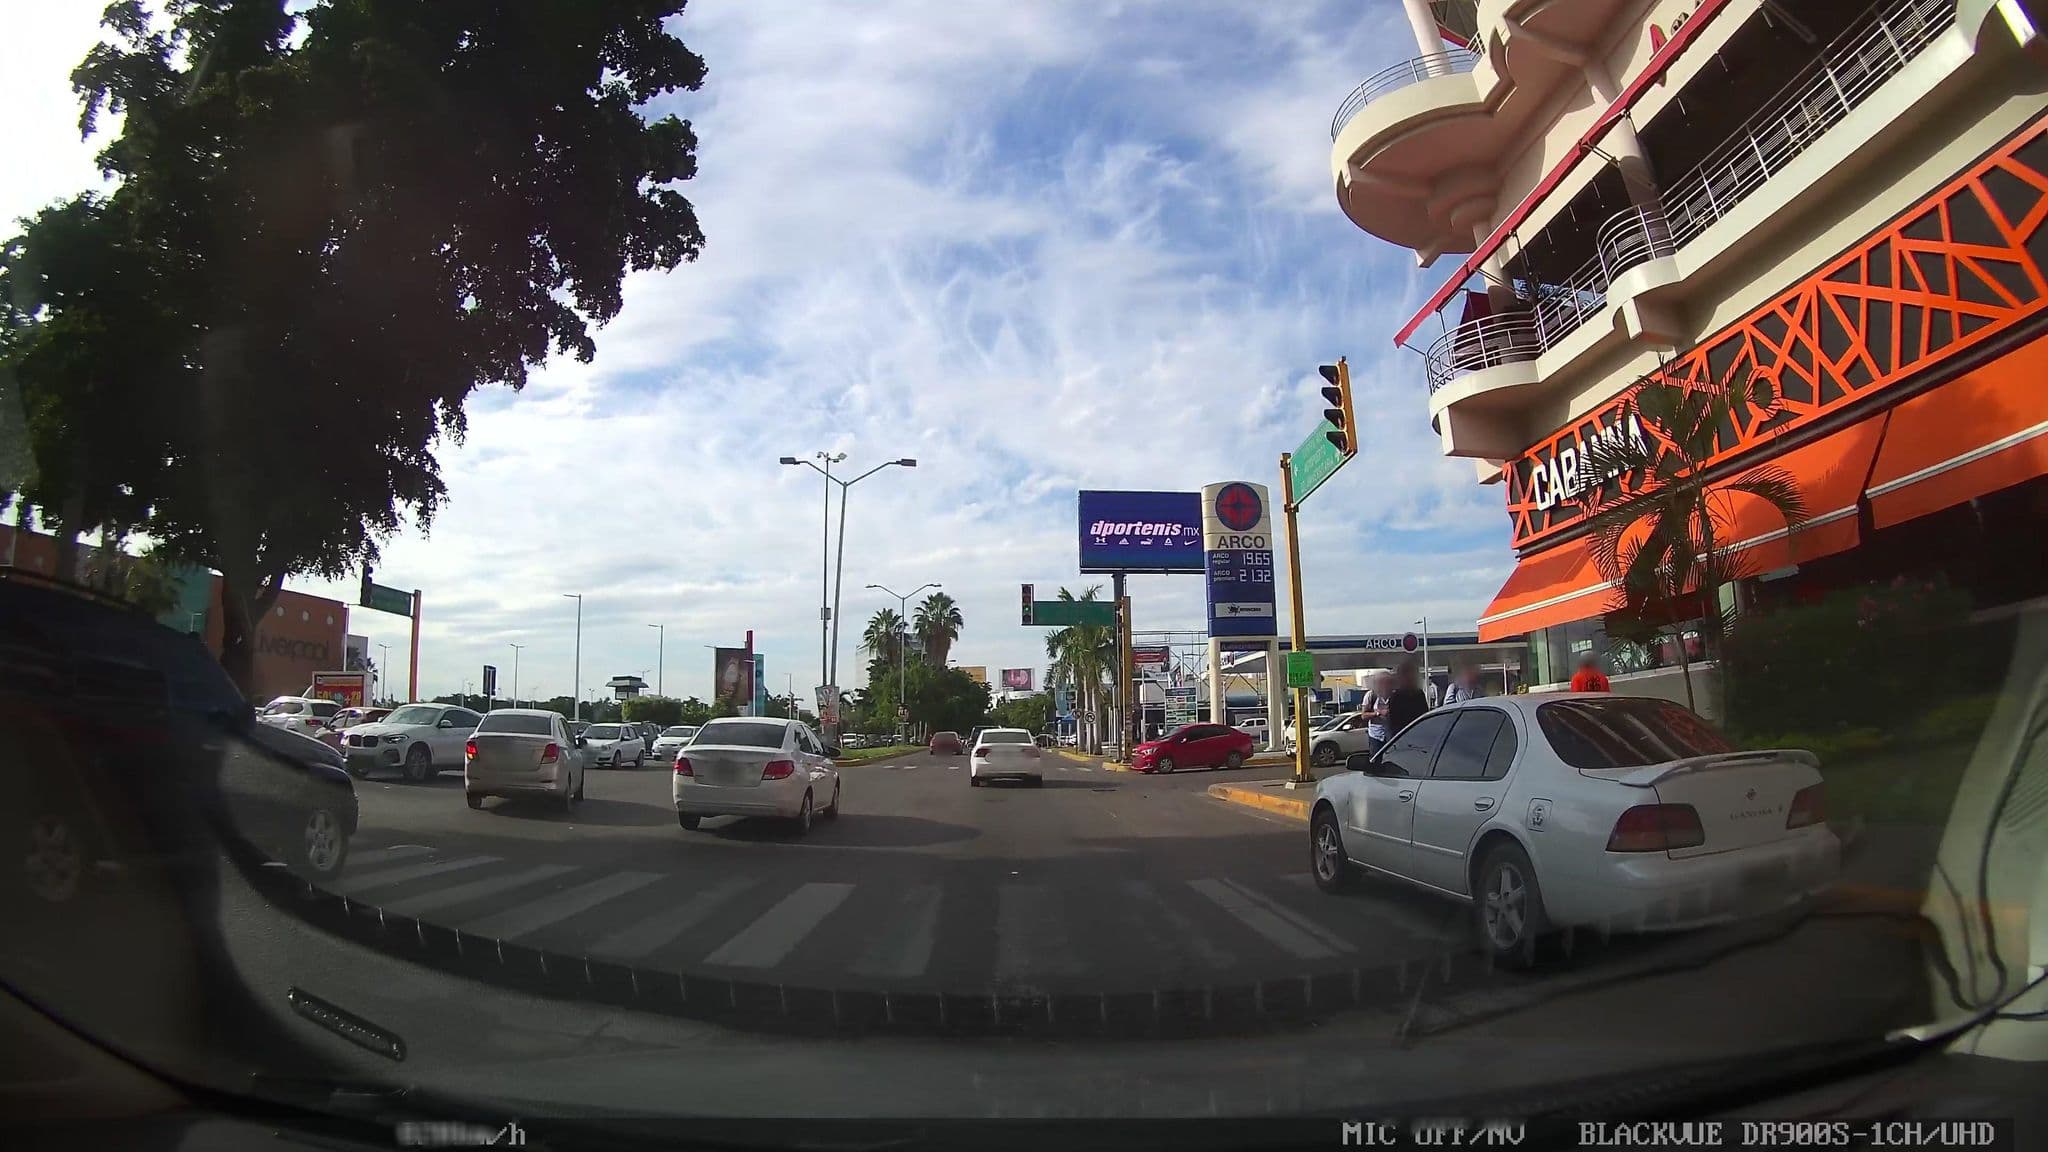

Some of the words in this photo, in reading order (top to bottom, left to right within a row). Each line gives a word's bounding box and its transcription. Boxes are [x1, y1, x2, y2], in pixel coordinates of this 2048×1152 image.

[1090, 520, 1199, 537] dportenis.mx
[1217, 535, 1265, 549] ARCO
[1243, 552, 1270, 565] 19.65
[1366, 638, 1397, 649] ARCO
